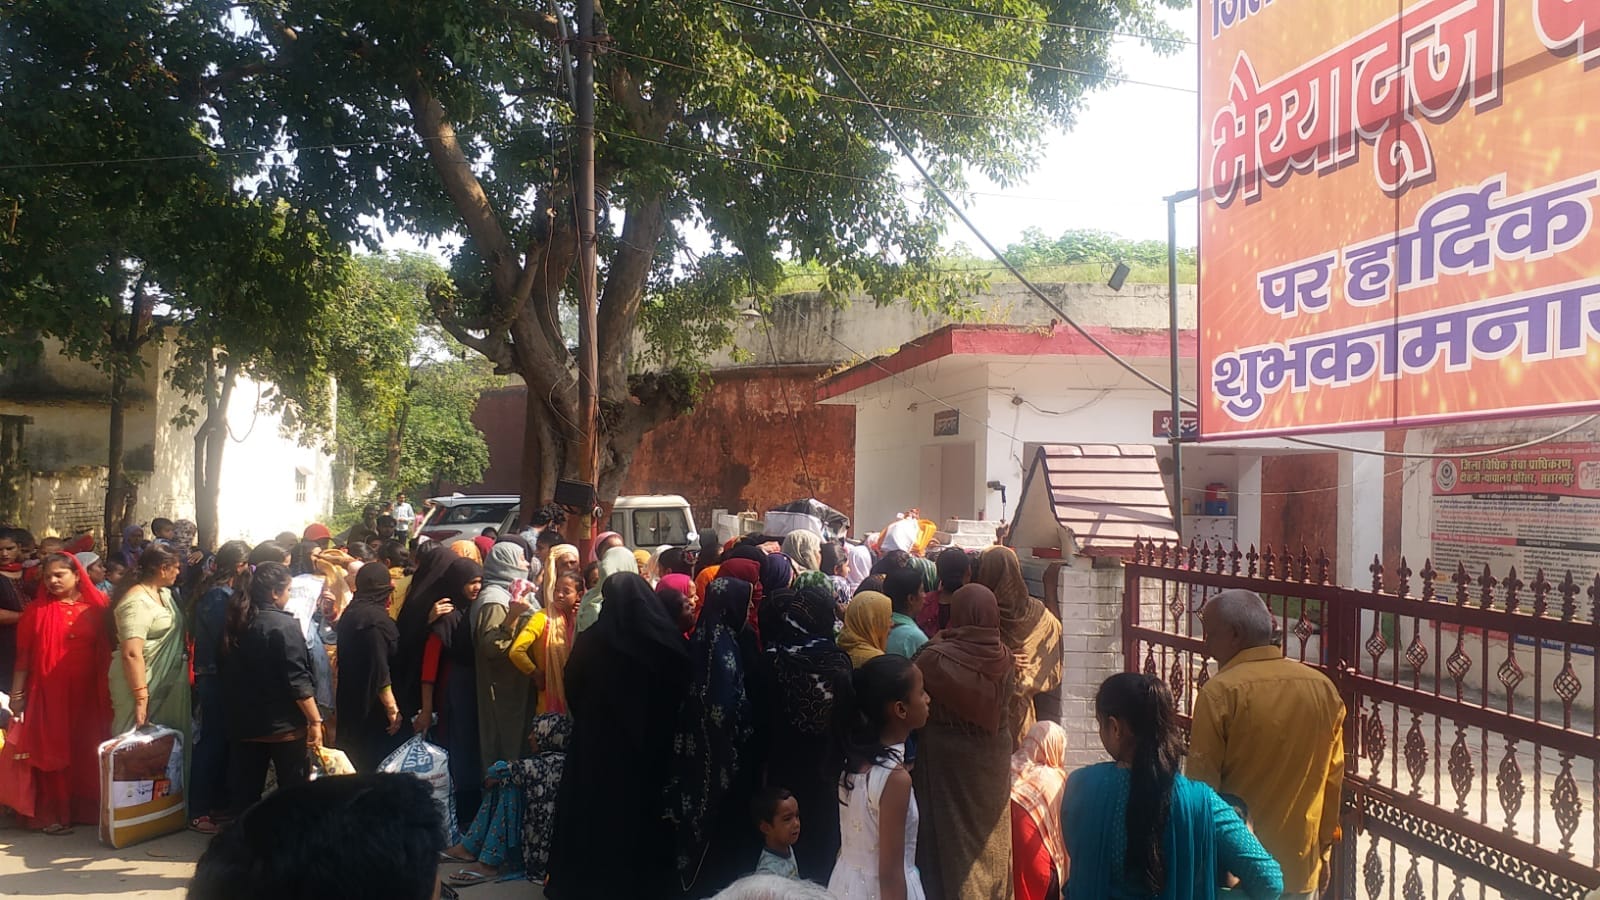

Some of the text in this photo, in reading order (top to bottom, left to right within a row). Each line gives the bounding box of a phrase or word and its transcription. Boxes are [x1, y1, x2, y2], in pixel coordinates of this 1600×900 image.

[1259, 176, 1600, 316] पर हार्दिक
[1213, 281, 1600, 420] शुभकामना
